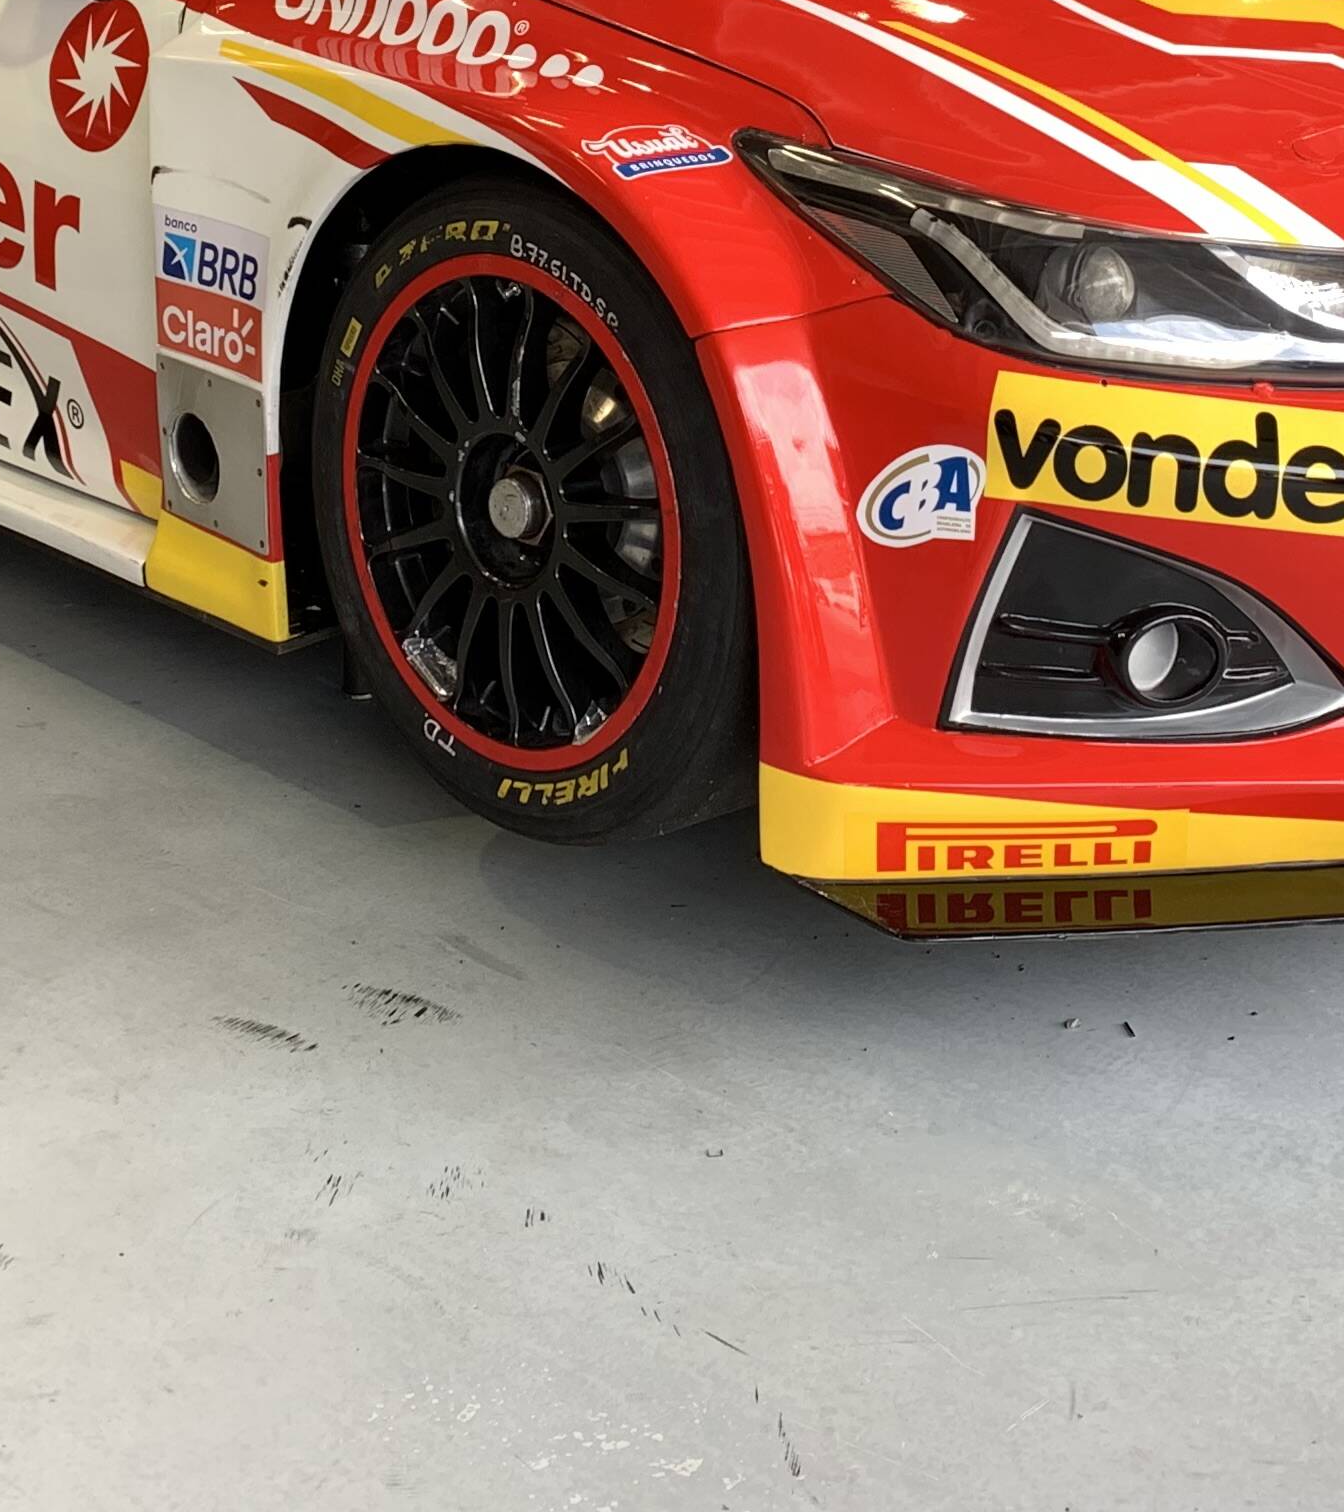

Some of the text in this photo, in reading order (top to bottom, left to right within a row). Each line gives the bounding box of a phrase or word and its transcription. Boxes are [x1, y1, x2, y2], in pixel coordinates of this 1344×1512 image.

[629, 152, 717, 172] BRINQUEDOS
[164, 214, 198, 233] banco
[197, 240, 259, 301] BRB
[162, 304, 256, 365] Claro
[878, 455, 973, 531] CBA
[876, 819, 1158, 873] PIRELLI
